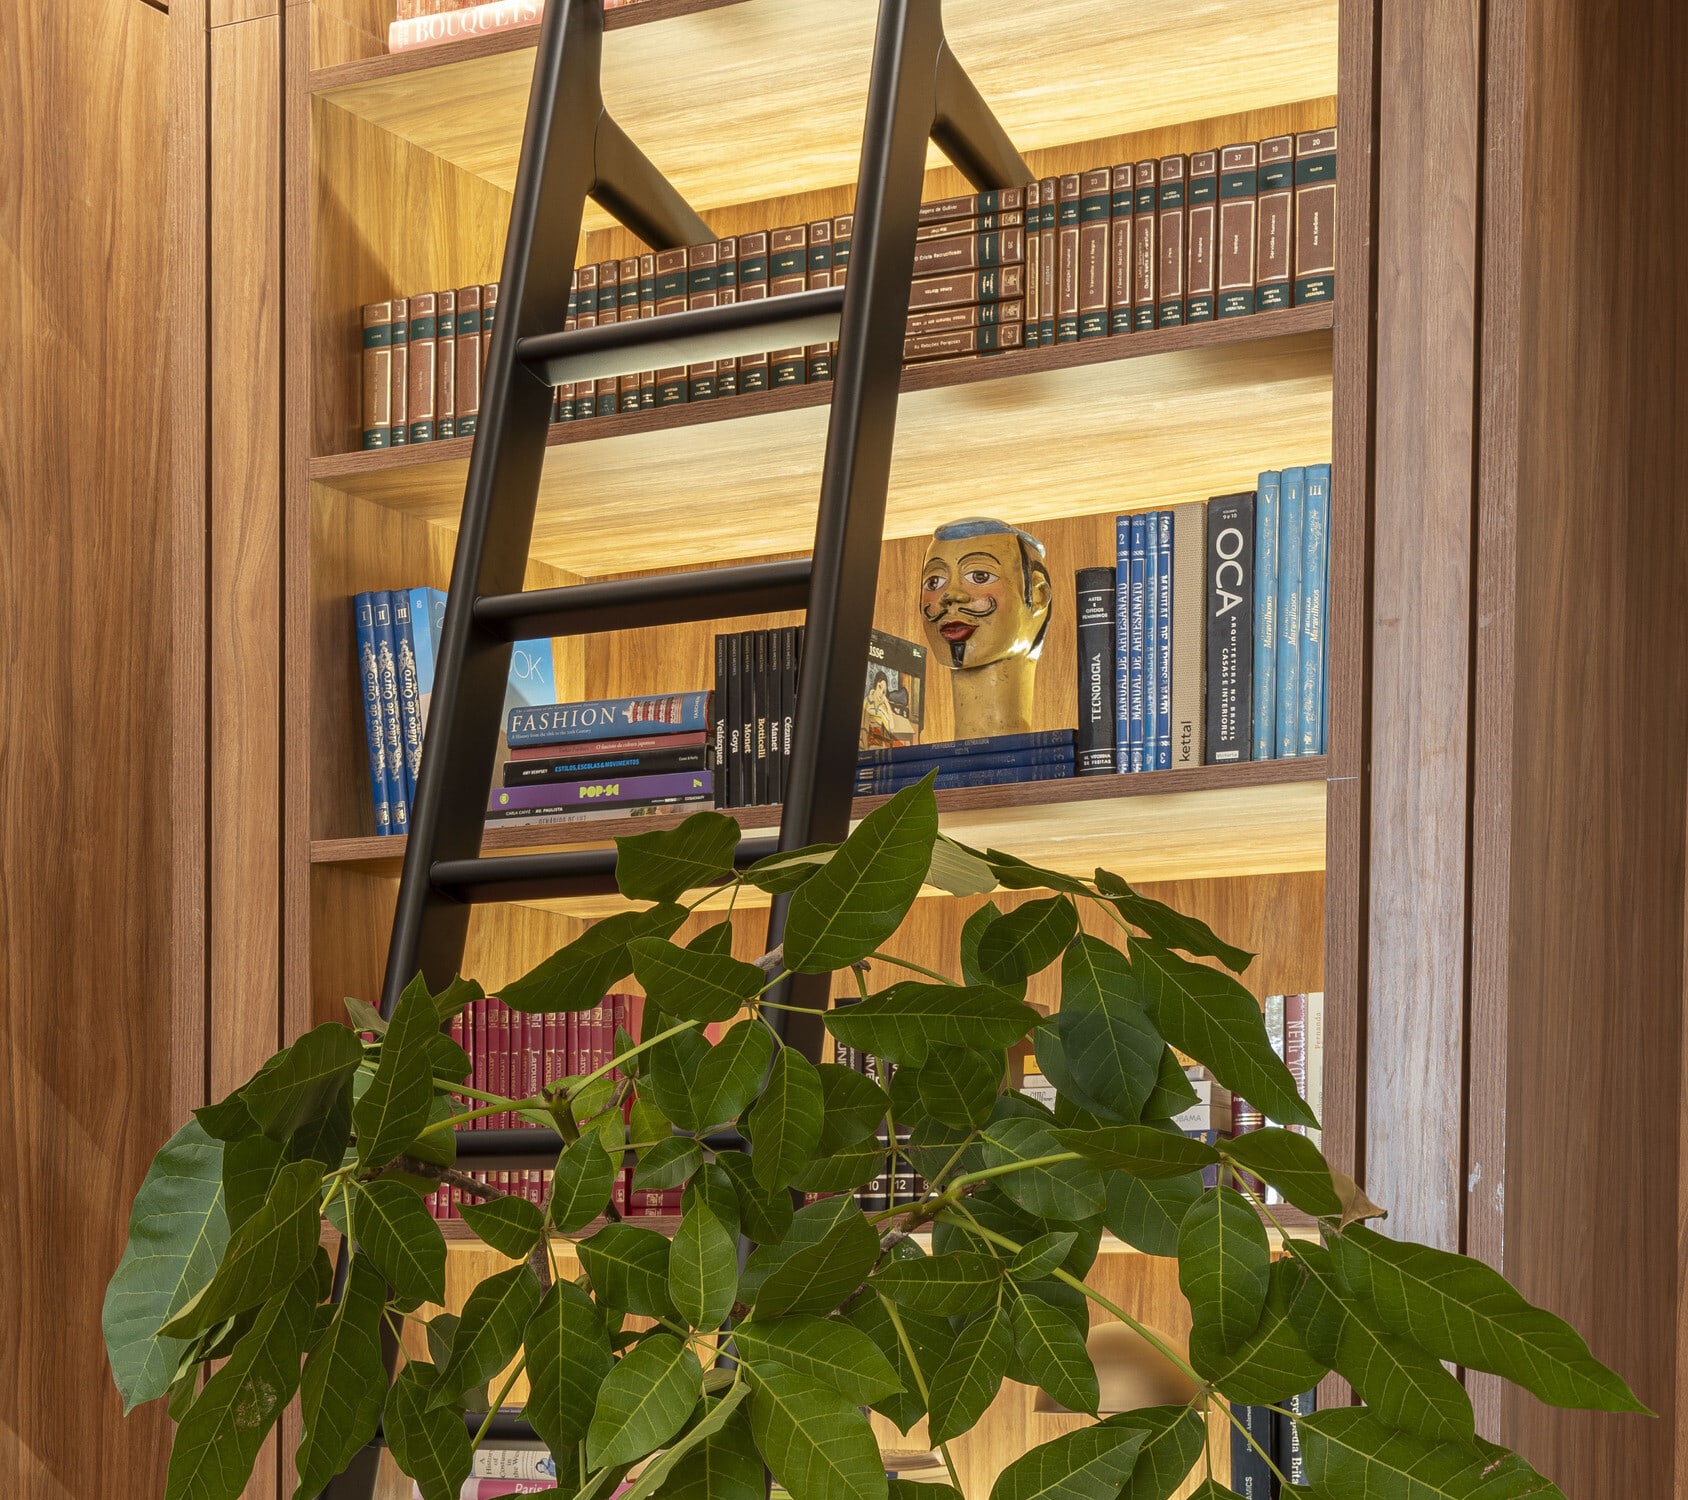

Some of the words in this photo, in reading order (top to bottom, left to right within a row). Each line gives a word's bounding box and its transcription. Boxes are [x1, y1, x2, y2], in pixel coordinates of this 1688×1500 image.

[416, 3, 537, 42] BOUQUETS
[1312, 138, 1321, 146] 20
[1309, 486, 1322, 496] III
[1118, 533, 1125, 545] 2
[1215, 527, 1244, 617] OCA
[378, 610, 385, 620] II
[397, 608, 407, 619] III
[1118, 582, 1127, 656] ARTESANATO
[1132, 582, 1142, 656] ARTESANATO
[1264, 596, 1272, 649] Maravilhosos
[1288, 592, 1296, 646] Maravilhosos
[1310, 589, 1320, 643] Maravilhosos
[1118, 657, 1127, 672] DE
[1132, 657, 1142, 672] DE
[368, 672, 377, 701] Ouro
[383, 670, 392, 700] Ouro
[403, 669, 413, 698] Ouro
[1092, 653, 1101, 722] TECNOLOGIA
[1118, 675, 1127, 721] MANUAL
[1132, 675, 1142, 721] MANUAL
[1230, 688, 1236, 702] NO
[370, 702, 378, 716] de
[387, 700, 394, 714] de
[405, 700, 414, 713] de
[511, 706, 616, 734] FASHION
[1221, 687, 1229, 741] INTERIORES
[715, 719, 725, 766] Velázquez
[731, 729, 740, 754] Goya
[744, 723, 752, 754] Monet
[758, 718, 766, 760] Botticelli
[784, 716, 793, 756] Cézanne
[1179, 721, 1191, 762] kettal
[1287, 1020, 1304, 1053] NEIL
[530, 1050, 540, 1093] Larousse
[546, 1048, 555, 1084] Larous
[869, 1180, 879, 1191] 10
[894, 1179, 906, 1190] 12
[493, 1457, 499, 1465] of
